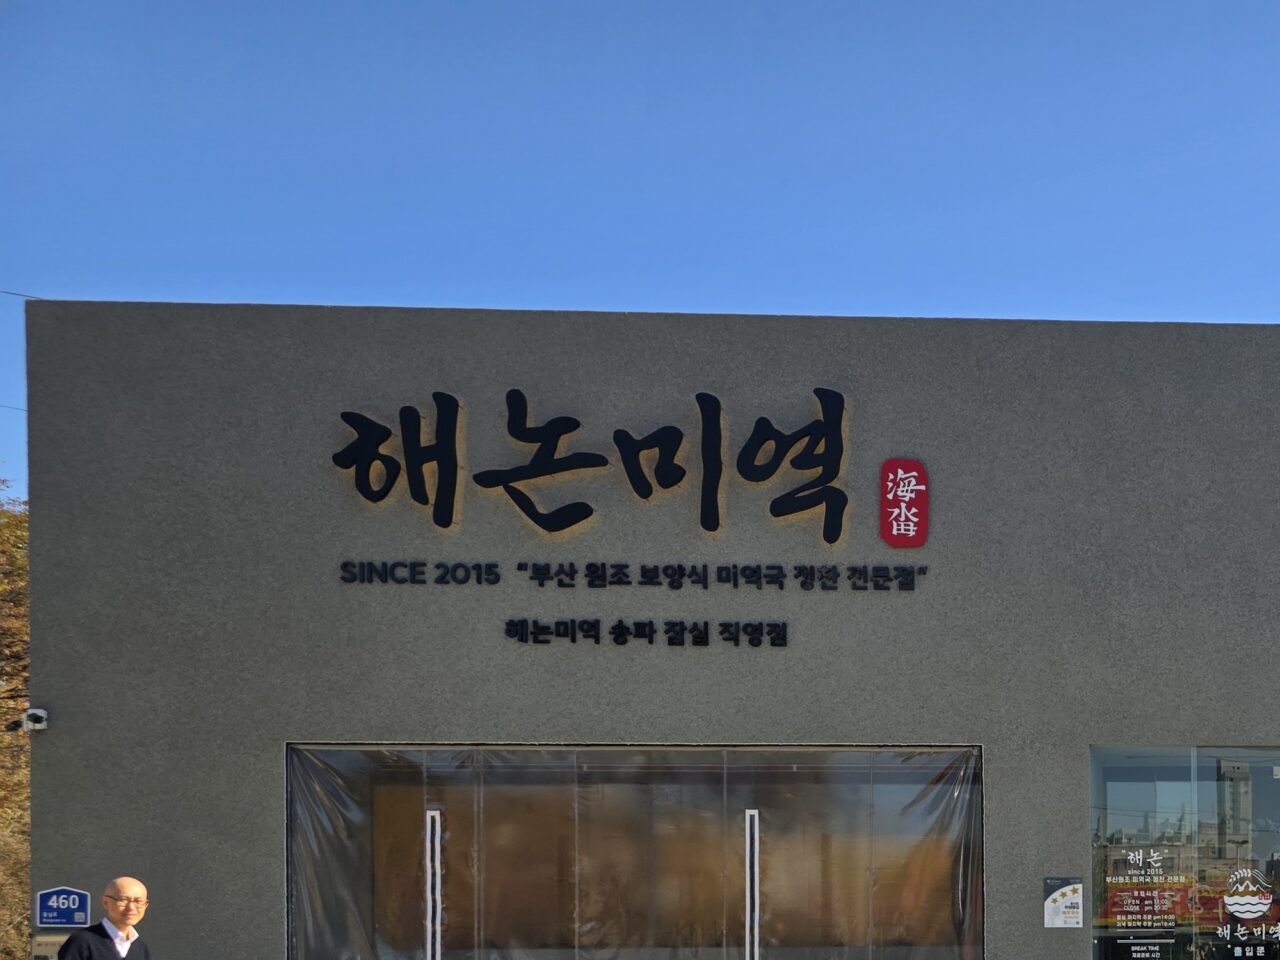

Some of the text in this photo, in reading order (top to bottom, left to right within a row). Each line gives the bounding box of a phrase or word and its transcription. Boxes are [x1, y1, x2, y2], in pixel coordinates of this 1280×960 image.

[331, 387, 849, 545] 해논미역
[339, 560, 427, 585] SINCE
[433, 562, 501, 586] 2015
[583, 562, 633, 589] 원조
[637, 563, 709, 591] 보양식
[715, 563, 788, 591] 미역국
[793, 564, 841, 592] 정찬
[504, 618, 788, 648] 해논미역 송파 잠실 직영점
[48, 895, 79, 909] 460
[1233, 946, 1266, 957] 출입문
